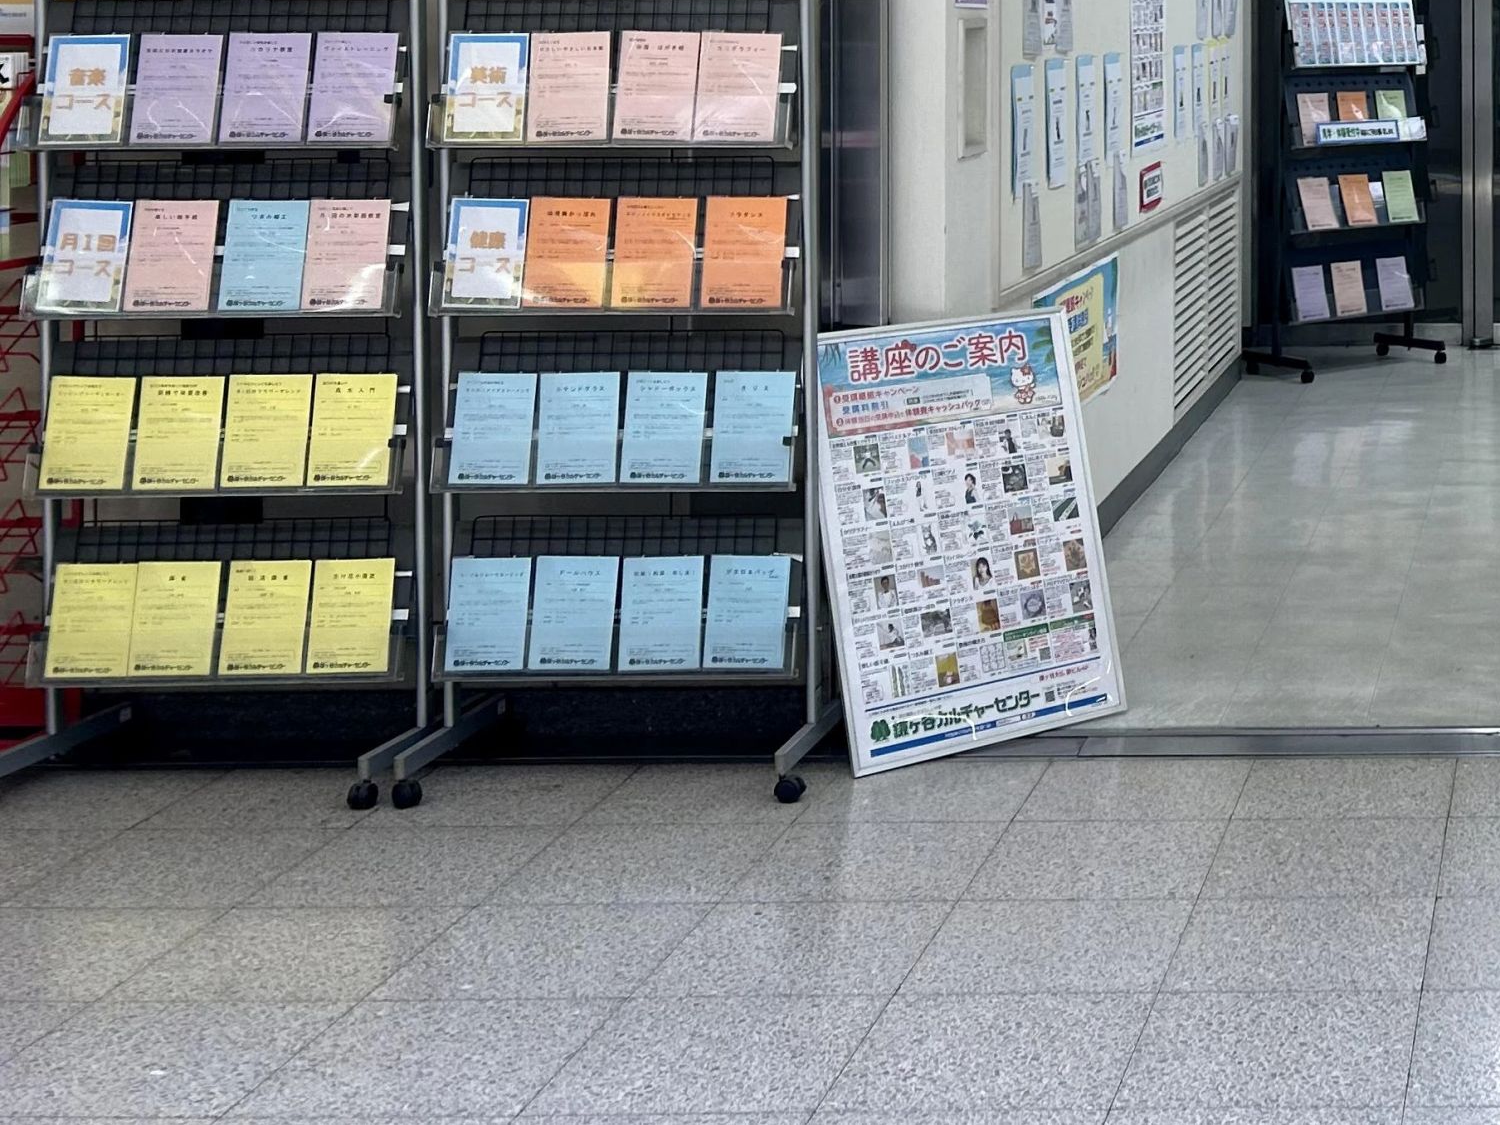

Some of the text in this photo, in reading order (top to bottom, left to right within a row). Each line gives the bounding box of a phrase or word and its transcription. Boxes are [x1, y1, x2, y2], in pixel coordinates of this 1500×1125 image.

[848, 330, 1027, 383] 講座のご案内
